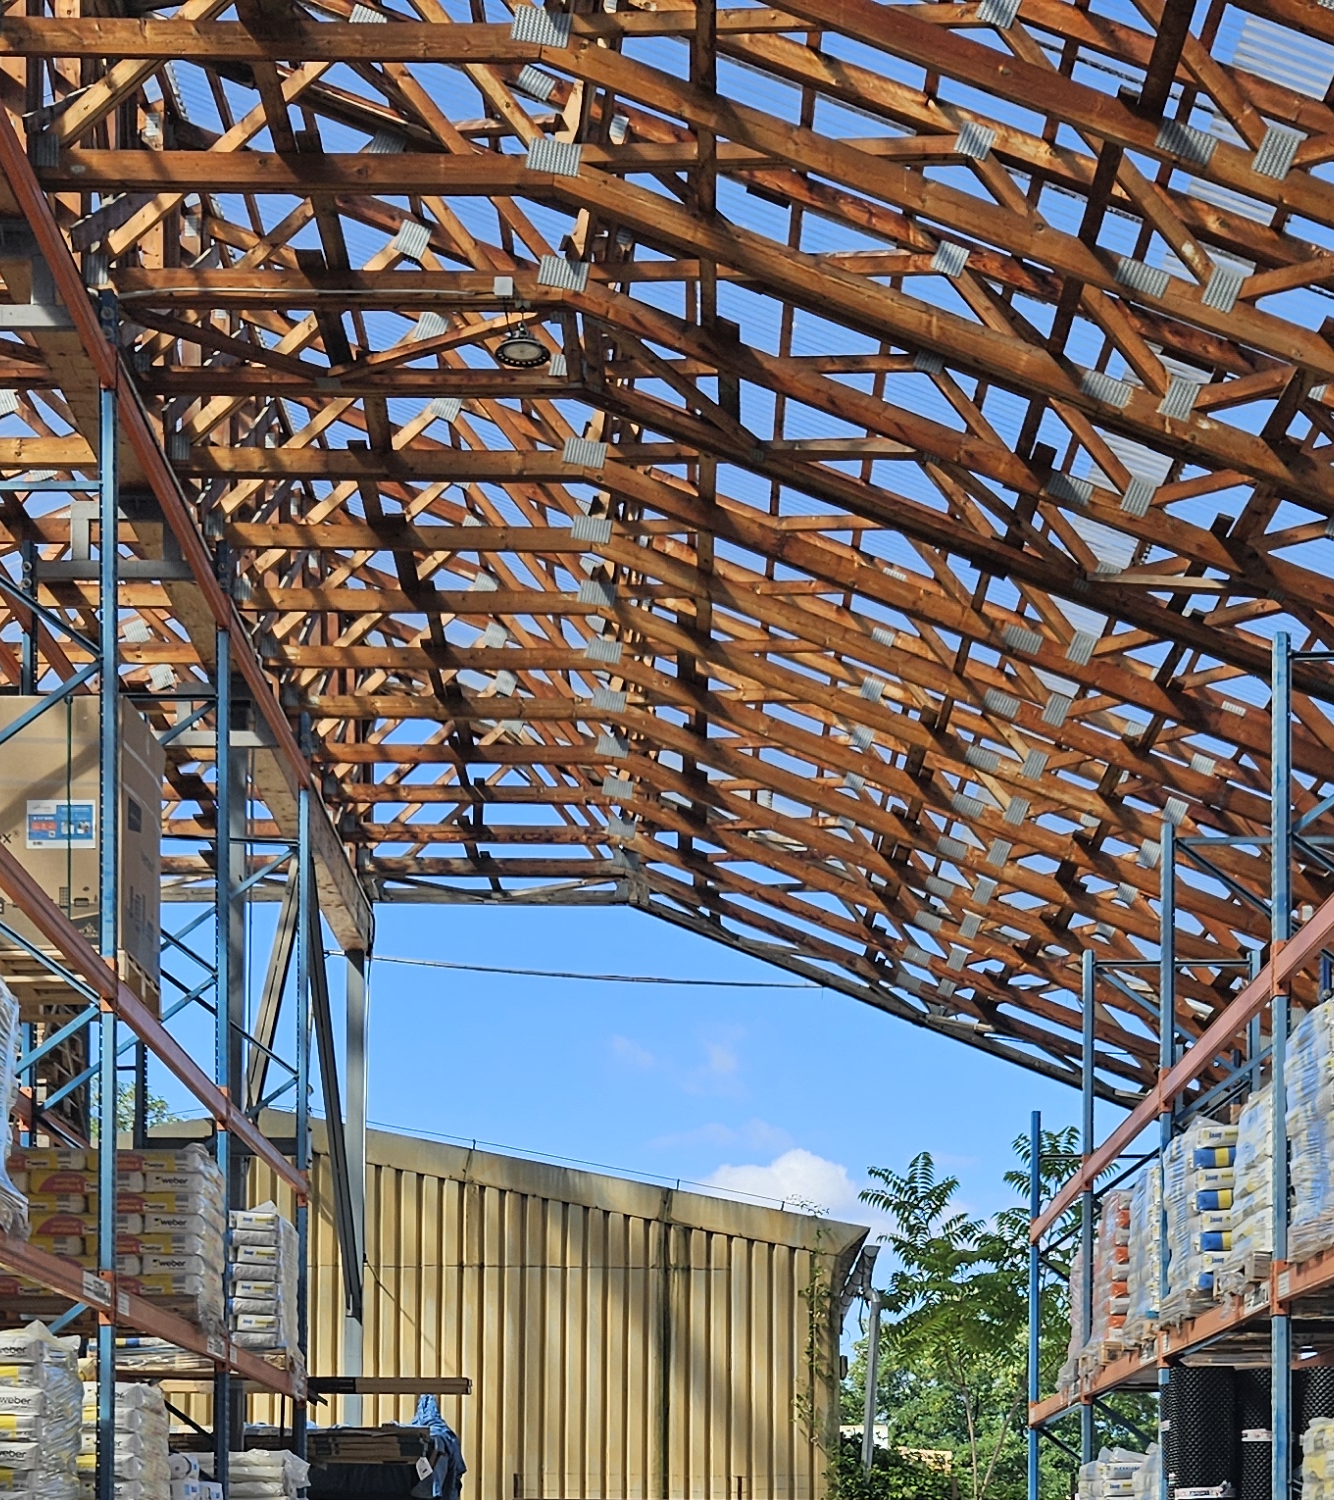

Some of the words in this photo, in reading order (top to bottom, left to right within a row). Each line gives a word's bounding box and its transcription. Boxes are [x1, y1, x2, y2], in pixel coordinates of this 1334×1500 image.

[160, 1176, 187, 1184] weber
[160, 1218, 187, 1226] weber
[159, 1259, 186, 1267] weber
[1, 1396, 32, 1405] weber
